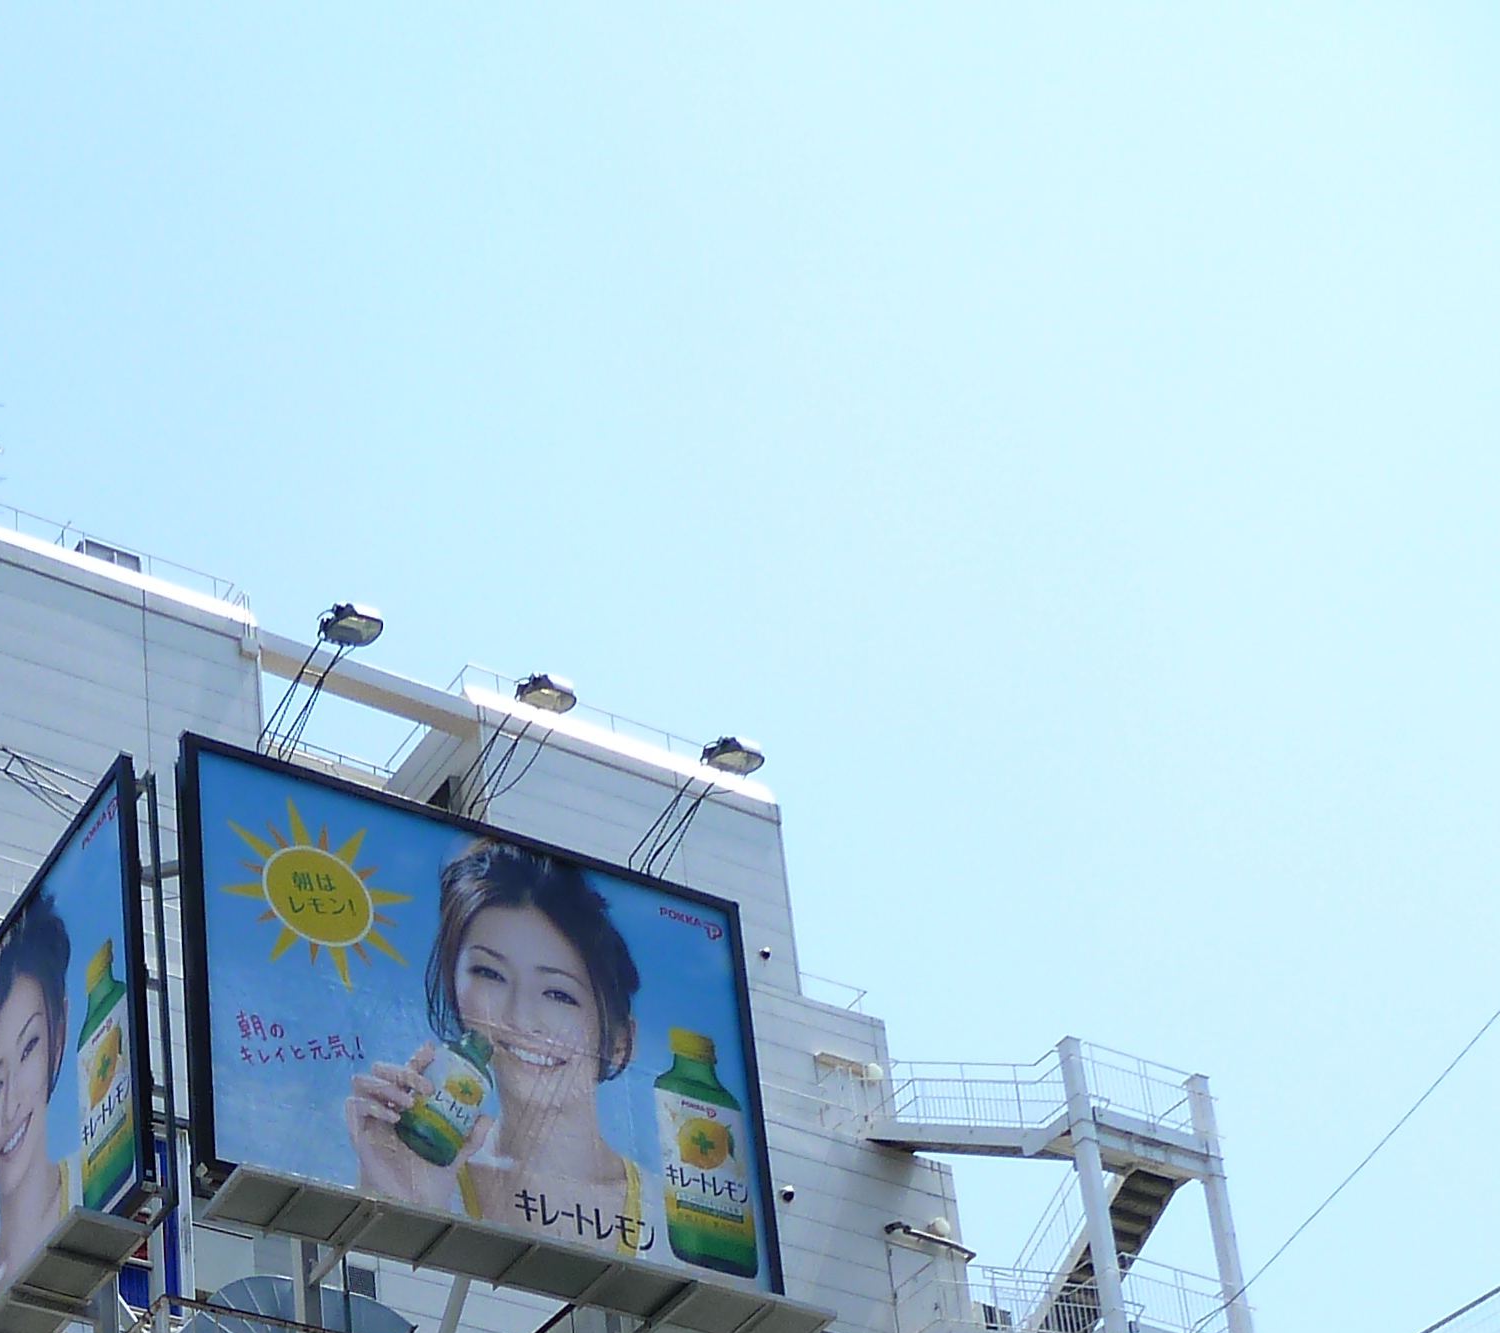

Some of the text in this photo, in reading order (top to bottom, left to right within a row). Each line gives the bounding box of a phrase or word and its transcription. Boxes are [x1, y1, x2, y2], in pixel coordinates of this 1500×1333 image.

[292, 869, 337, 893] 朝は
[288, 892, 359, 919] レモン!
[658, 905, 703, 929] POKKA
[236, 1009, 286, 1042] 朝の
[239, 1034, 367, 1064] キレイと元気!
[665, 1163, 749, 1204] キレートレモン
[513, 1188, 656, 1252] キレートレモン
